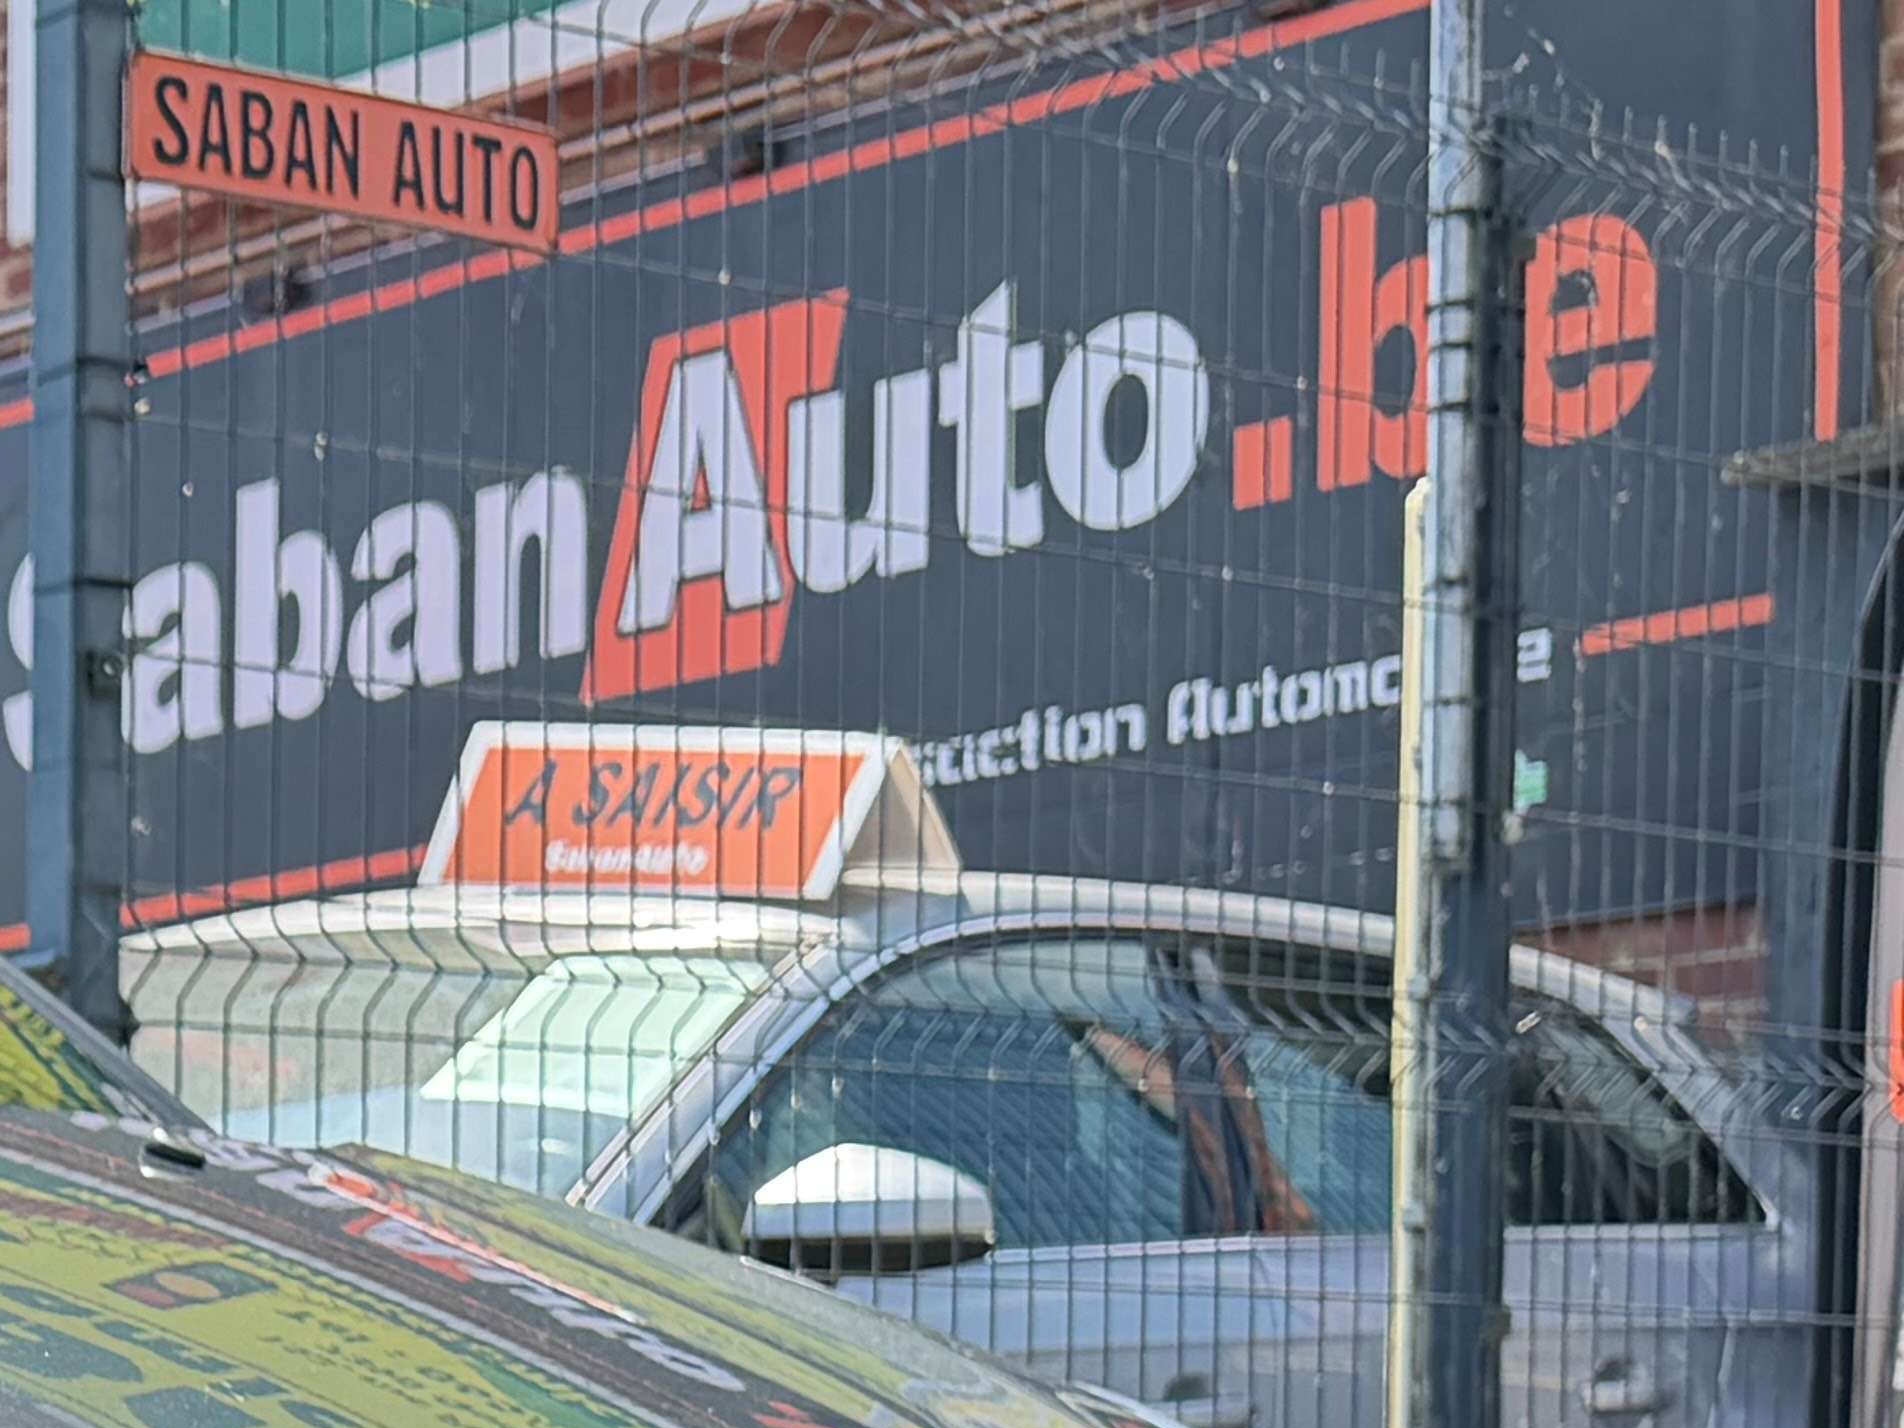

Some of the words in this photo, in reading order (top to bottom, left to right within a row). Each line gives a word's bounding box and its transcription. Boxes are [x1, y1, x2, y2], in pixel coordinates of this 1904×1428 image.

[153, 76, 360, 200] SABAN
[394, 121, 539, 231] AUTO
[3, 196, 1657, 772] abanAuto.be
[503, 757, 558, 828] A
[570, 758, 802, 832] SAISIR
